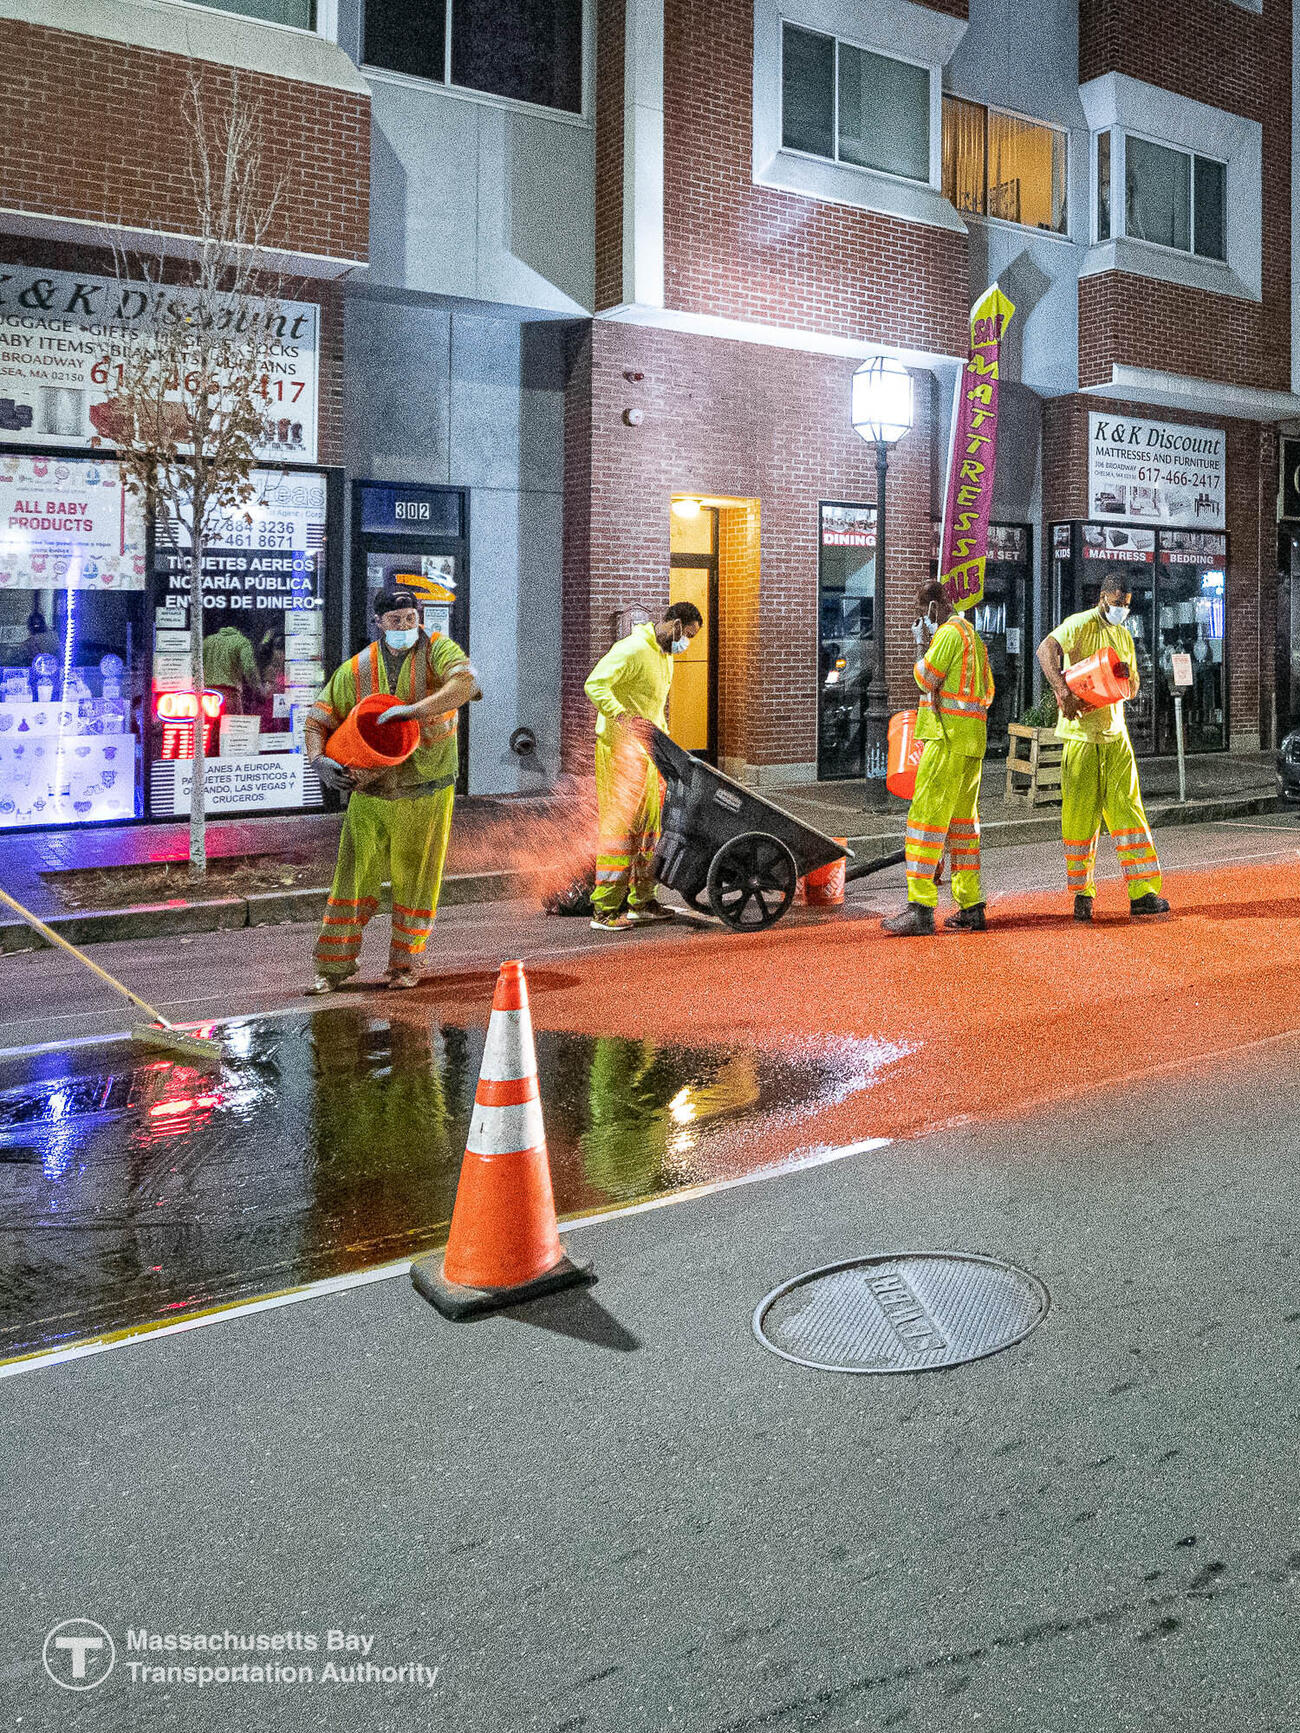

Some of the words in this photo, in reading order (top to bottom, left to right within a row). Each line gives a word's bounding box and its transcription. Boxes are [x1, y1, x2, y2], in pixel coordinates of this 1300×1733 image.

[18, 278, 58, 311] &
[64, 282, 103, 316] K
[0, 314, 75, 333] GGAGE
[39, 336, 95, 355] ITEMS
[2, 351, 85, 369] BROADWAY
[52, 371, 85, 383] 02150
[1094, 421, 1109, 441] K
[1111, 423, 1126, 444] &
[1128, 425, 1142, 446] K
[1146, 428, 1221, 455] Discount
[952, 353, 999, 557] MATTRESS
[1095, 446, 1151, 462] MATTRESSES
[1153, 453, 1172, 464] AND
[1174, 456, 1220, 470] FURNITURE
[1138, 466, 1221, 489] 617-466-2417
[14, 500, 42, 514] ALL
[46, 501, 88, 515] BABY
[396, 502, 429, 519] 302
[9, 517, 93, 532] PRODUCTS
[258, 521, 295, 535] 3236
[225, 535, 252, 548] 461
[258, 535, 293, 549] 8671
[824, 533, 876, 546] DINING
[997, 551, 1020, 560] SET
[1055, 548, 1071, 559] KIDS
[1089, 549, 1146, 562] MATTRESS
[1169, 554, 1214, 564] BEDDING
[250, 557, 315, 572] AEREOS
[245, 573, 312, 590] PÚBLICA
[230, 596, 254, 609] DE
[257, 596, 315, 609] DINERO
[235, 763, 243, 773] A
[290, 772, 297, 781] A
[235, 783, 253, 793] LAS
[255, 782, 286, 792] VEGAS
[288, 781, 295, 790] Y
[213, 794, 265, 805] CRUCEROS
